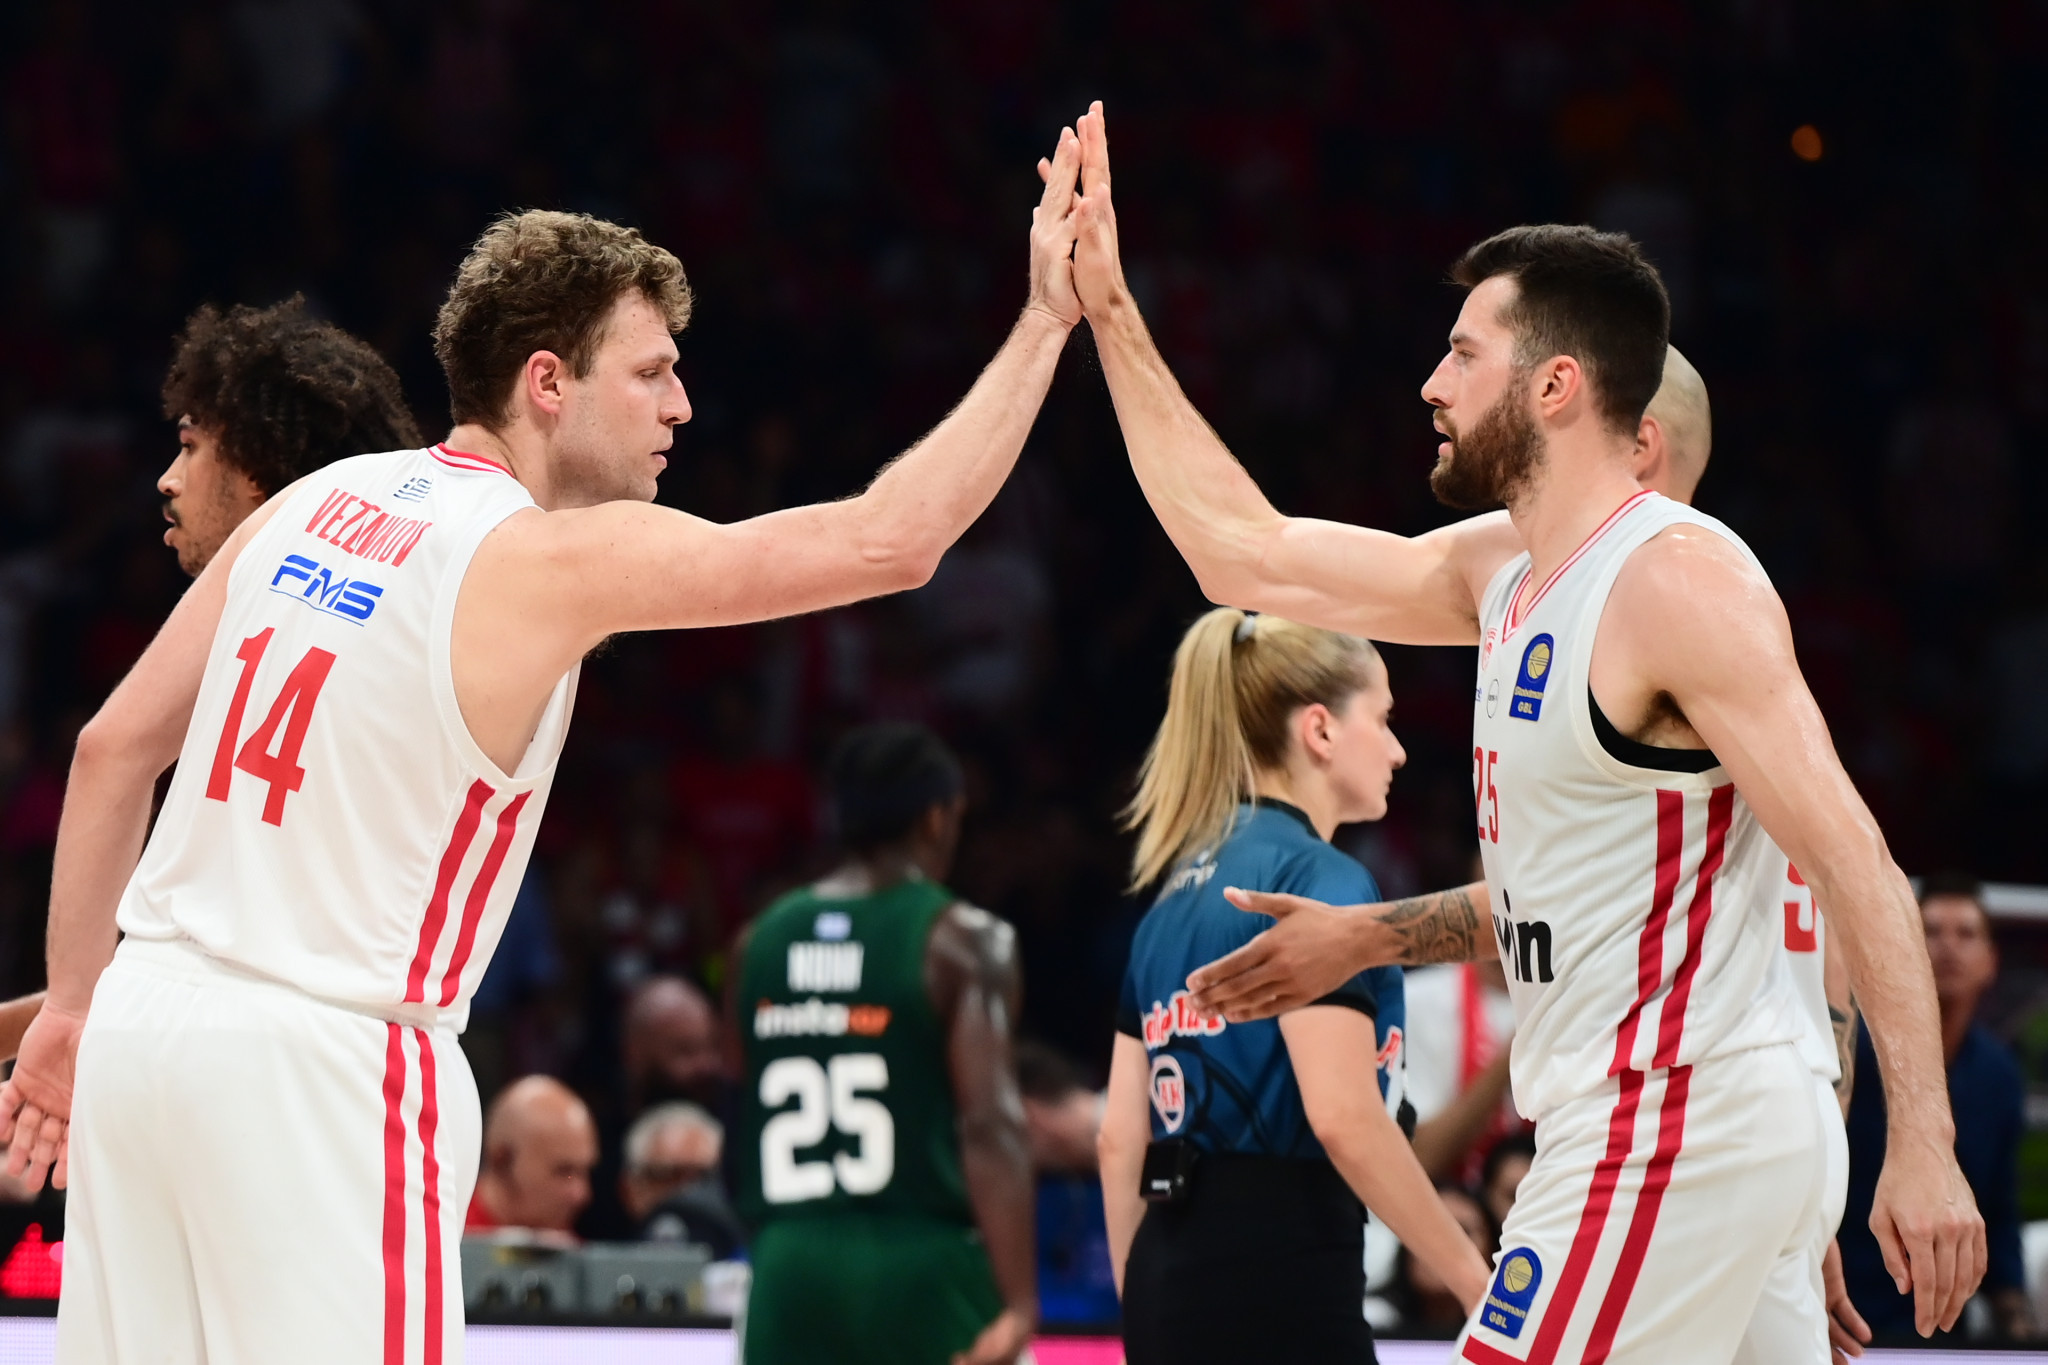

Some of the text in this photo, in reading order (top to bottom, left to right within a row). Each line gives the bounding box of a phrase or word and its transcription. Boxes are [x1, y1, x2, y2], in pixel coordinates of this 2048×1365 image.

[271, 553, 384, 621] FMS
[205, 626, 337, 828] 14
[1518, 701, 1534, 715] GBL
[1474, 746, 1499, 844] 25
[759, 1053, 895, 1204] 25
[1489, 1311, 1508, 1330] GBL
